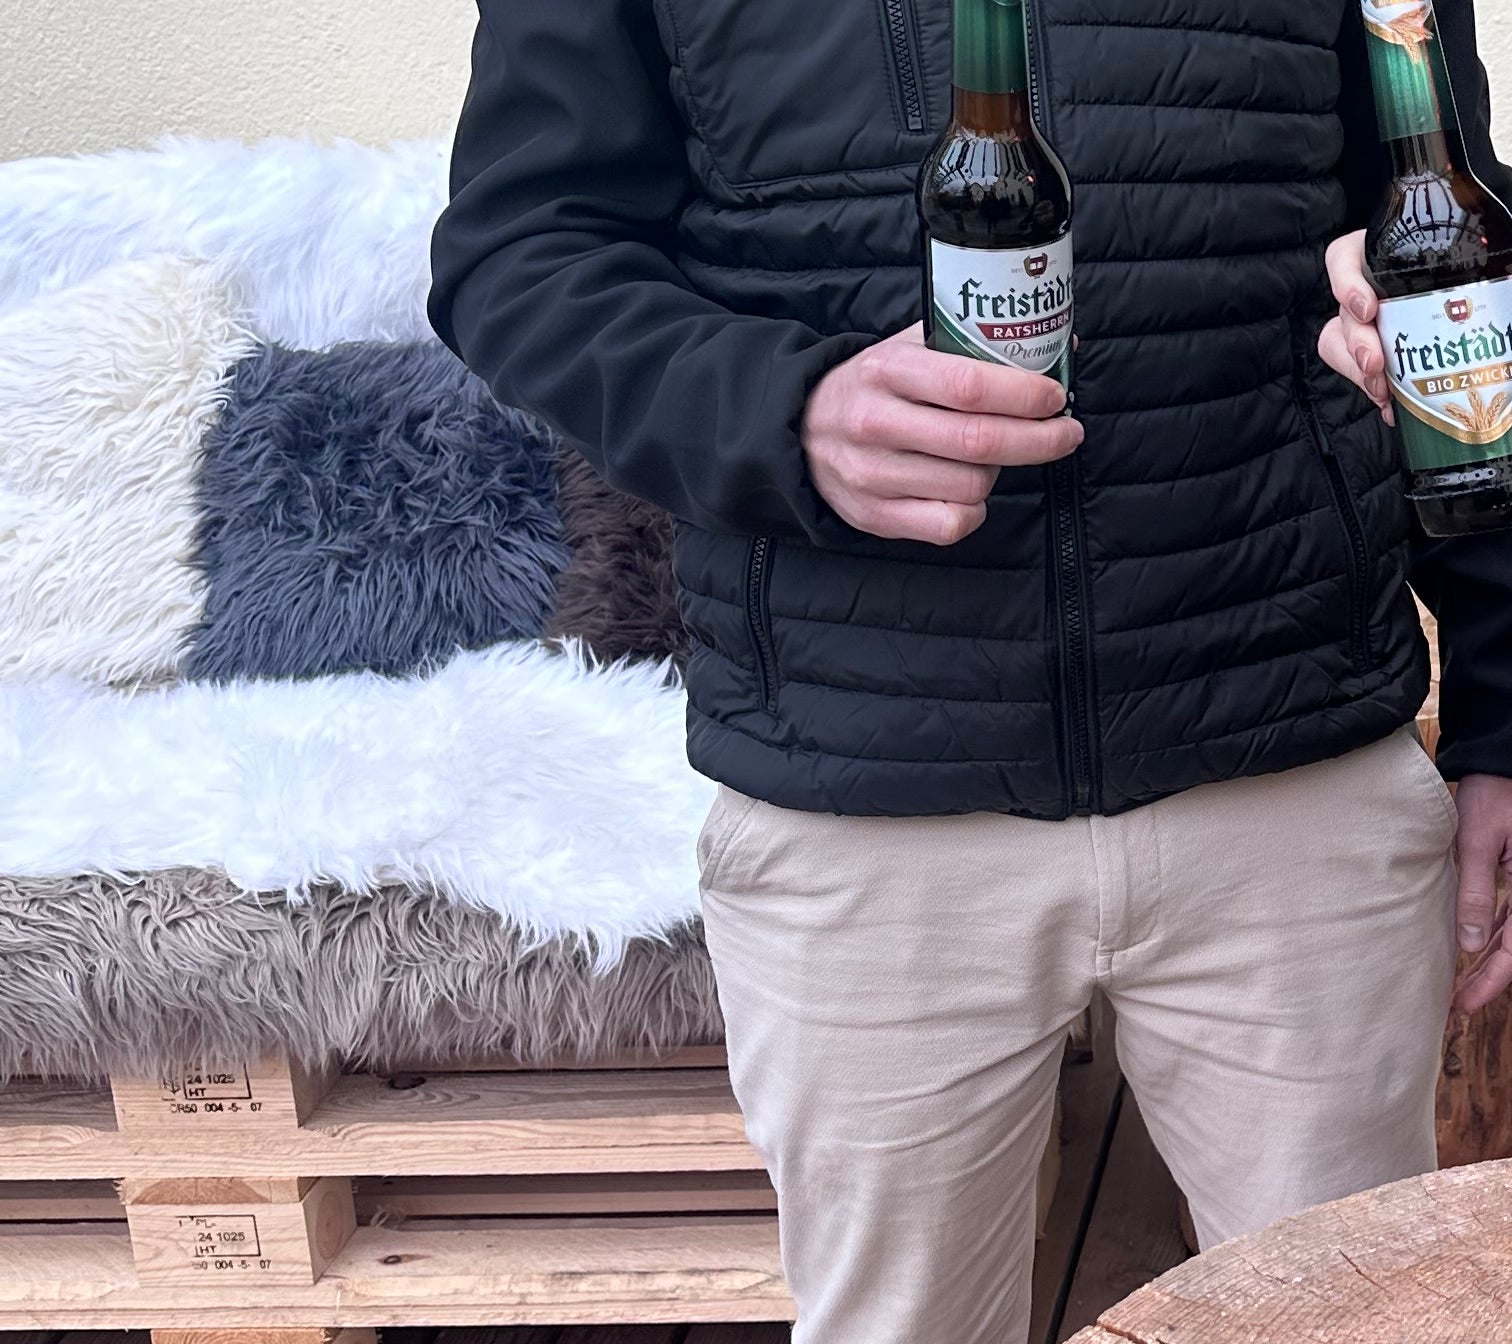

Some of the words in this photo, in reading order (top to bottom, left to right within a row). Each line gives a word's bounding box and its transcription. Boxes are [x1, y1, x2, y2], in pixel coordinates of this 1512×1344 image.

[993, 311, 1069, 339] RATSHERRN
[1427, 378, 1454, 393] BIO
[187, 1074, 202, 1084] 24
[206, 1074, 235, 1084] 1025
[188, 1088, 206, 1097] HT
[198, 1232, 212, 1242] 24
[216, 1232, 245, 1242] 1025
[199, 1245, 217, 1254] HT
[259, 1259, 271, 1269] 07
